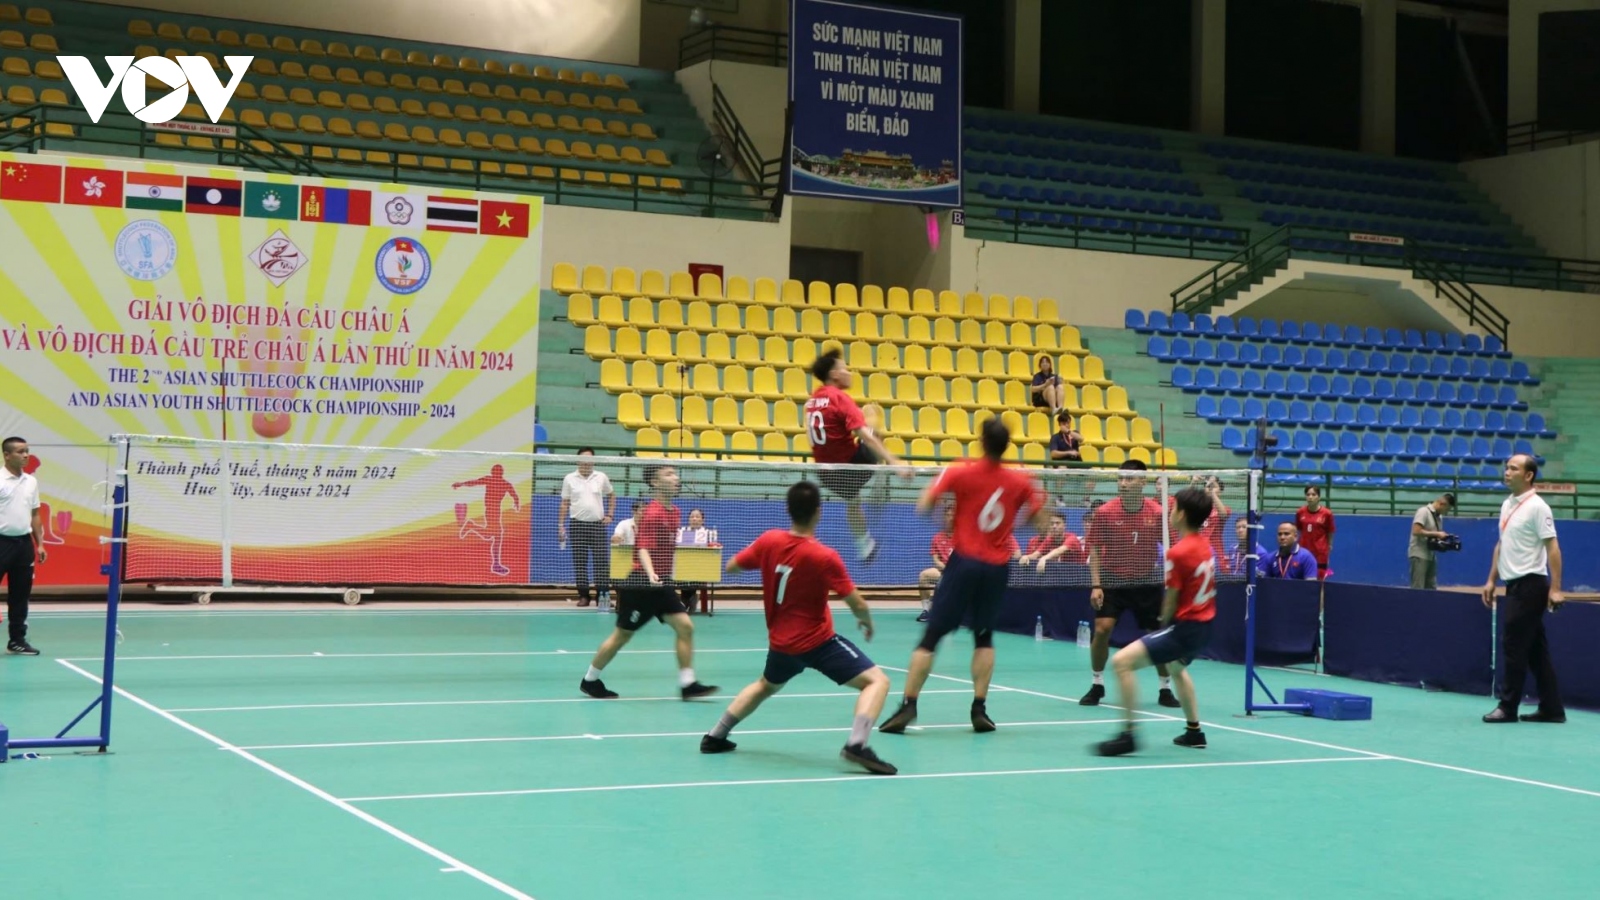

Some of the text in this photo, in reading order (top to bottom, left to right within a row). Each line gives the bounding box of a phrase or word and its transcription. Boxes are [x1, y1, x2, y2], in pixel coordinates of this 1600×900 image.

[812, 21, 943, 57] SỨC MẠNH VIỆT NAM
[813, 51, 843, 73] TINH
[883, 58, 910, 83] VIỆT
[912, 64, 942, 84] NAM
[820, 78, 935, 111] VÌ MỘT MÀU XANH
[846, 107, 909, 137] BIỂN, ĐẢO
[138, 260, 154, 270] SFA
[128, 294, 411, 334] GIẢI VÔ ĐỊCH ĐÁ CẦU CHÂU Á
[2, 323, 514, 372] VÀ VÔ ĐỊCH ĐÁ CẦU TRẺ CHÂU Á LẦN THỨ II NĂM 2024
[108, 367, 139, 384] THE
[163, 370, 208, 387] ASIAN
[210, 371, 316, 391] SHUTTLECOCK
[319, 375, 425, 395] CHAMPIONSHIP
[67, 391, 101, 408] AND
[102, 392, 149, 409] ASIAN
[151, 394, 204, 411] YOUTH
[206, 396, 313, 415] SHUTTLECOCK
[316, 399, 421, 418] CHAMPIONSHIP
[430, 403, 457, 419] 2024
[137, 460, 187, 475] Thành
[190, 458, 221, 479] phố
[265, 463, 309, 480] tháng
[312, 465, 322, 477] 8
[326, 465, 358, 478] năm
[362, 466, 397, 480] 2024
[183, 481, 351, 500] Hue ity, August 2024
[977, 486, 1005, 533] 6
[775, 563, 794, 605] 7
